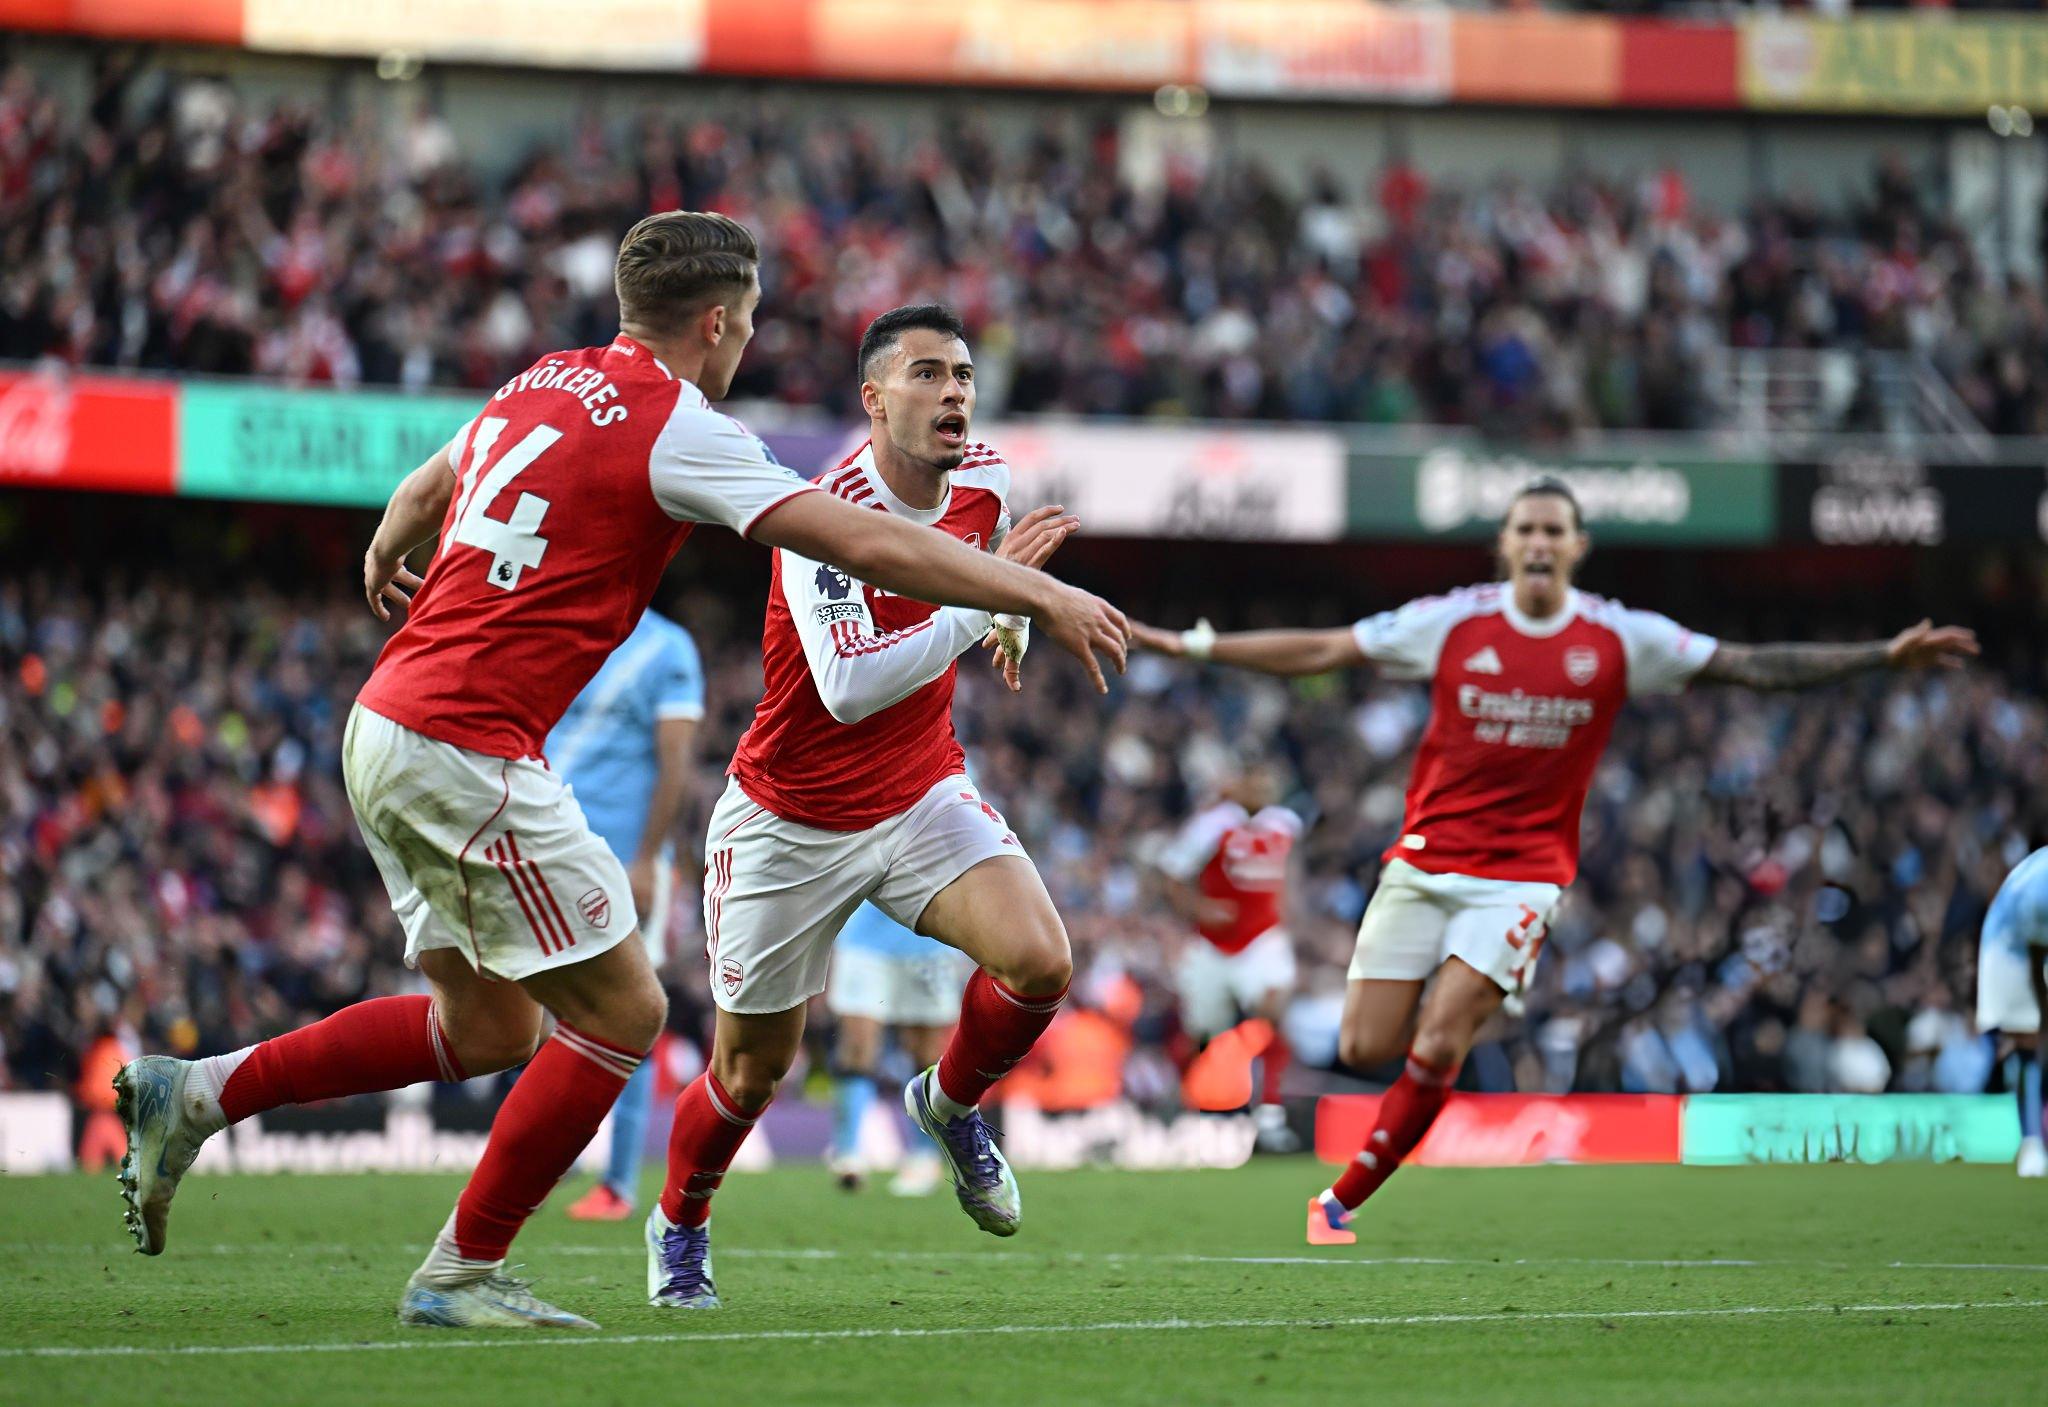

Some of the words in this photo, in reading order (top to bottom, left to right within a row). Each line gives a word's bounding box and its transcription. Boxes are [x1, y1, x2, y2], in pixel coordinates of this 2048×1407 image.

[494, 359, 628, 427] GYÖKERES
[441, 417, 564, 591] 14
[832, 605, 860, 613] room
